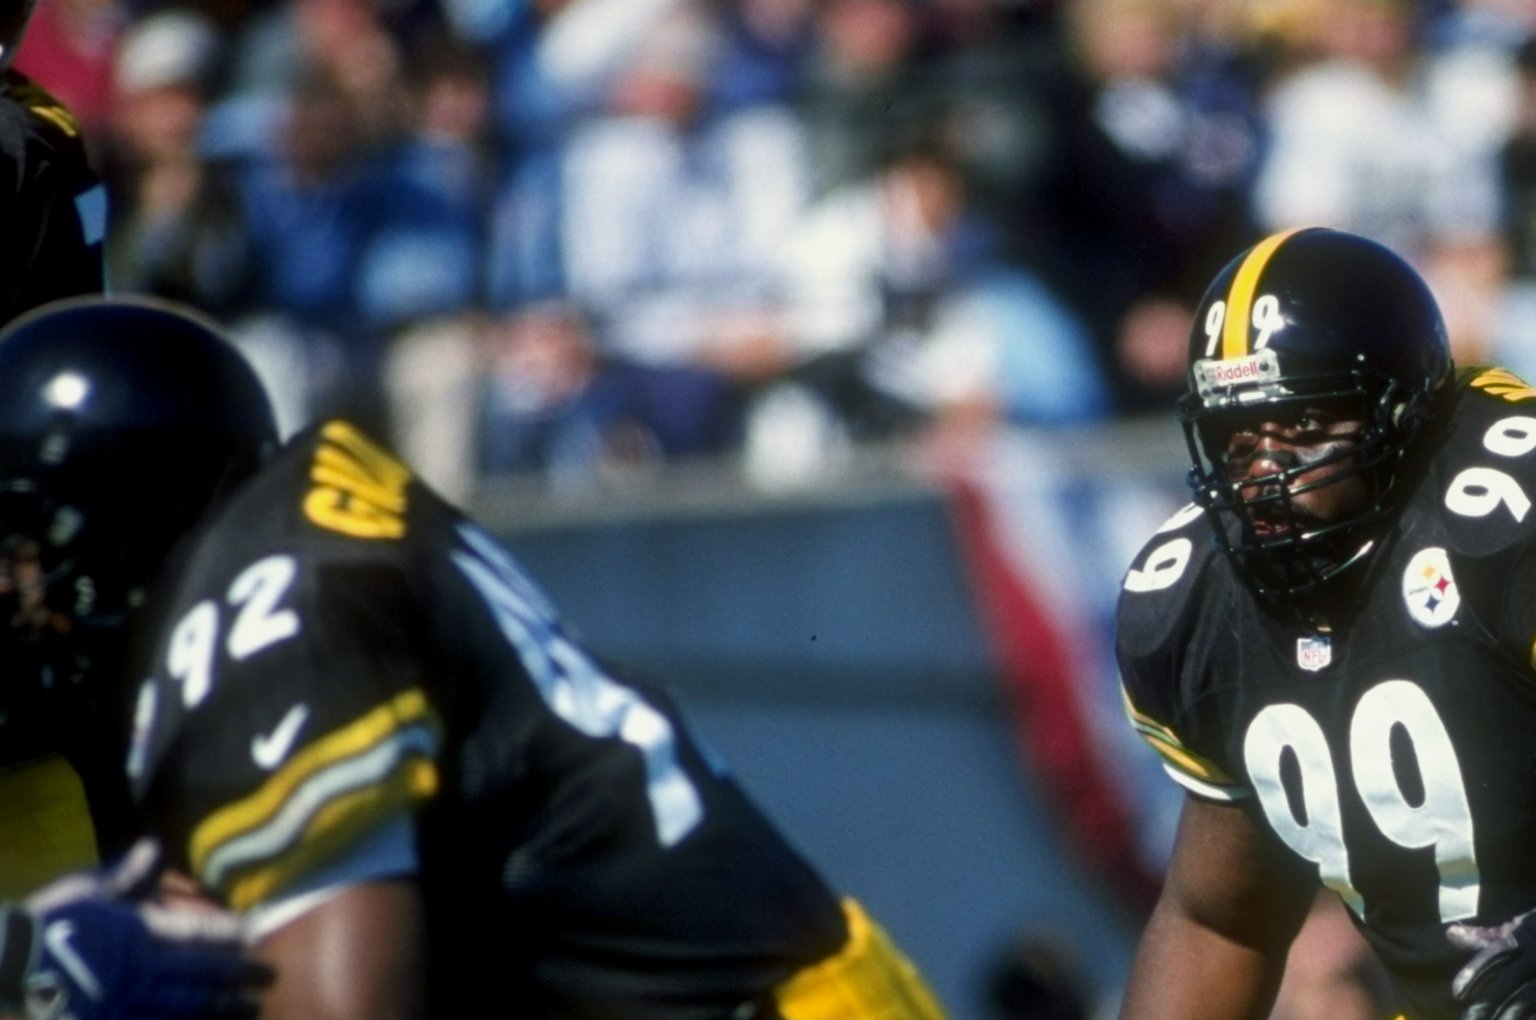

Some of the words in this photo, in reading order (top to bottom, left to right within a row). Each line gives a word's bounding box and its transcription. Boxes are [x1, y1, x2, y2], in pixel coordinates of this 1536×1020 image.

[1216, 361, 1258, 381] Riddell
[166, 552, 301, 710] 92
[1243, 679, 1481, 924] 99
